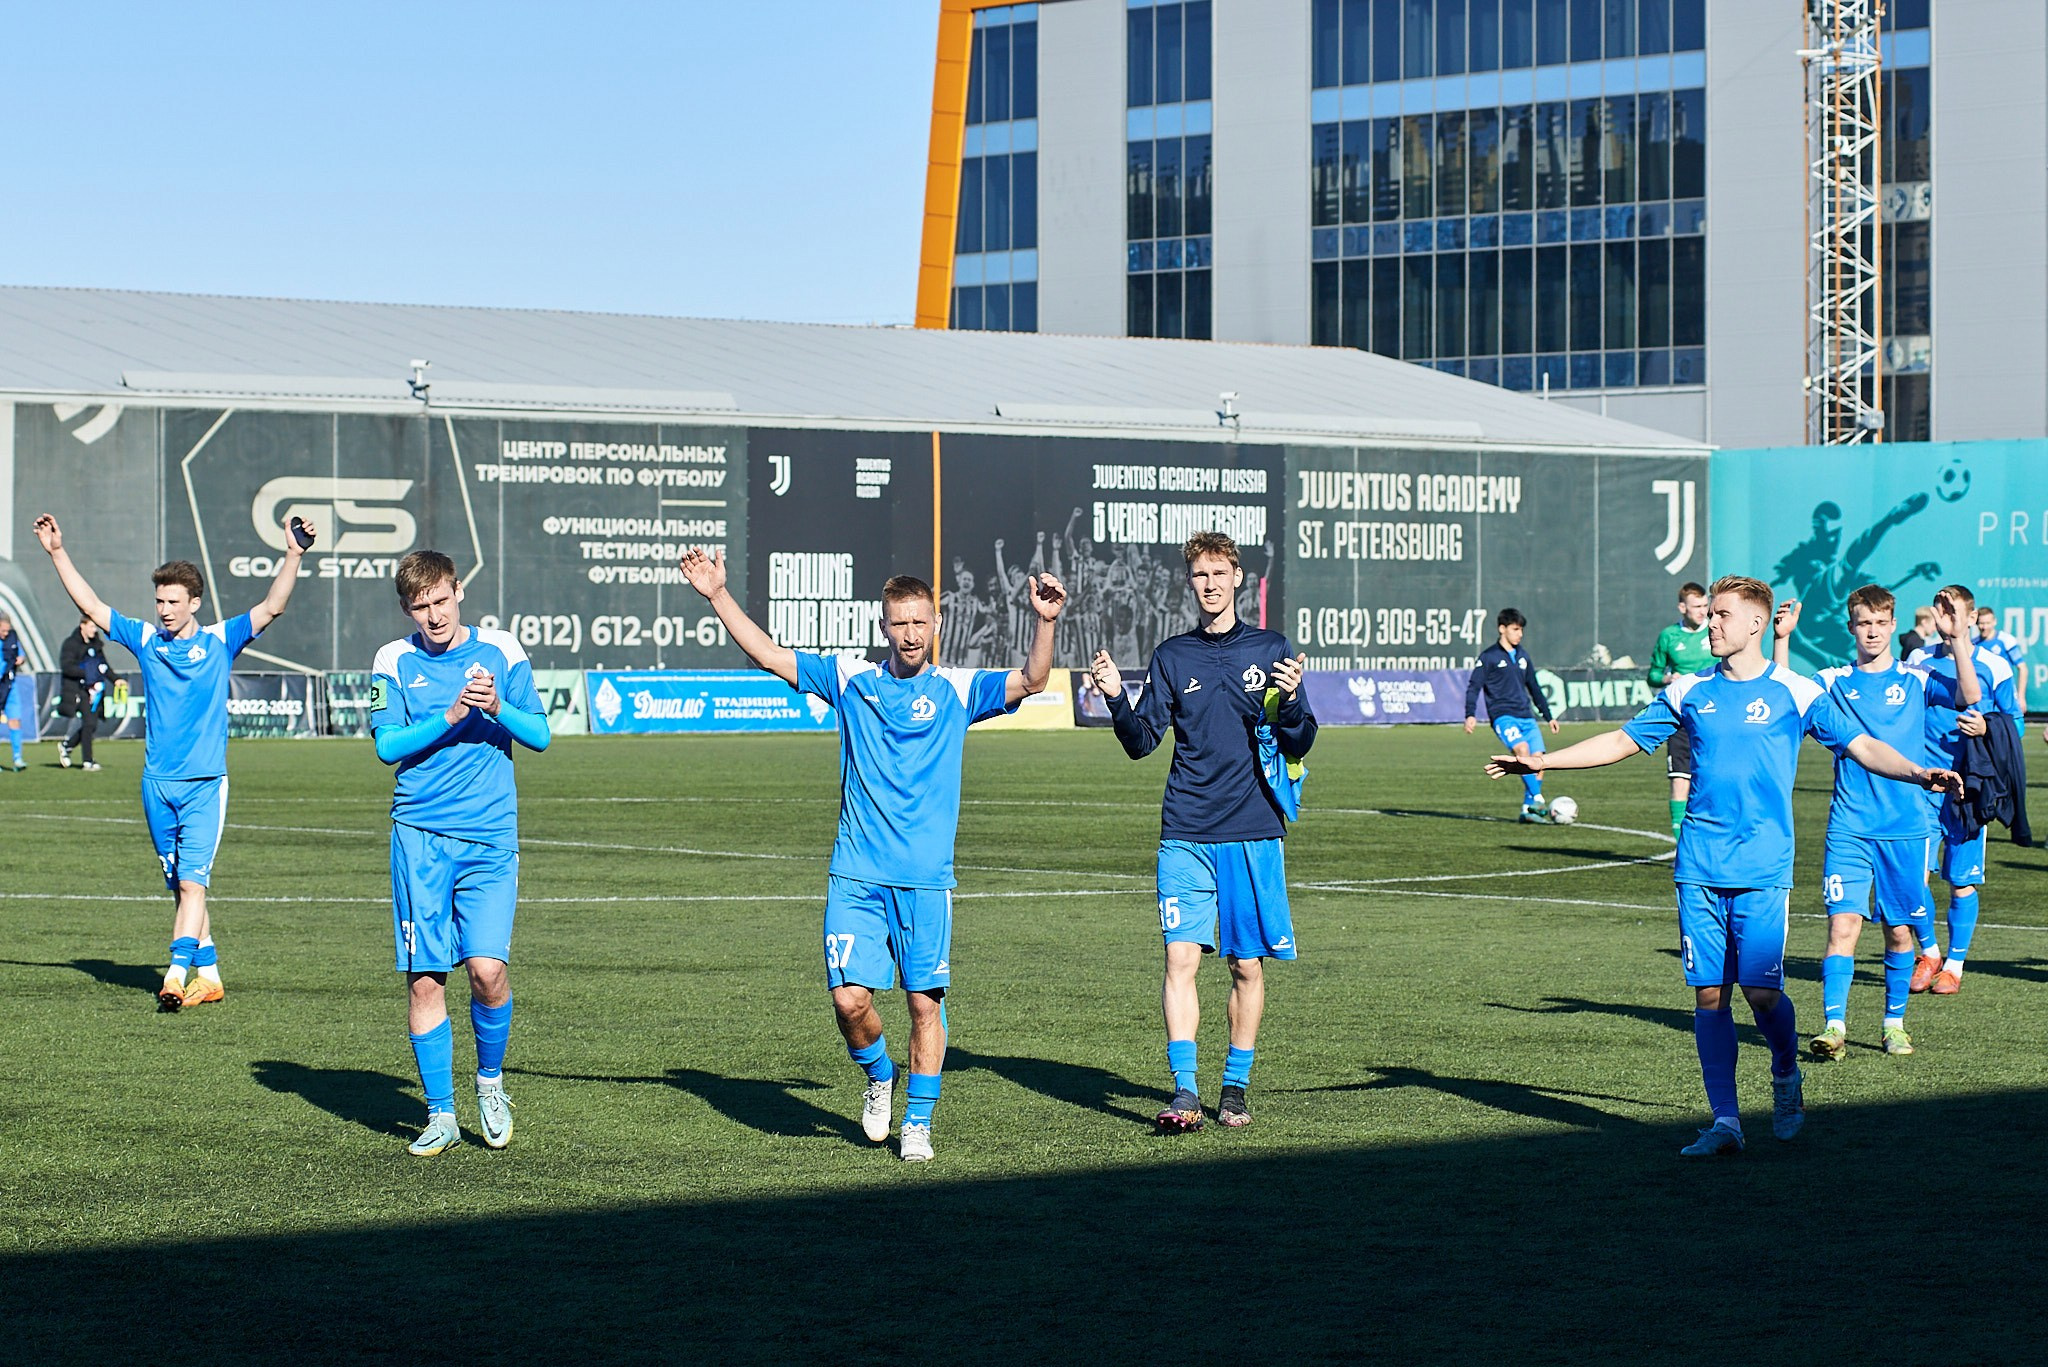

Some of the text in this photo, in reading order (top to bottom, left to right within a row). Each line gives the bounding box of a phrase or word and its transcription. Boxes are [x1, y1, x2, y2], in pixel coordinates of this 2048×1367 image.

[503, 440, 727, 464] ЦЕНТР ПЕРСОНАЛЬНЫХ
[474, 464, 727, 488] ТРЕНИРОВОК ПО ФУТБОЛУ
[1092, 464, 1267, 494] JUVENTUS ACADEMY RUSSIA
[1297, 471, 1521, 513] JUVENTUS ACADEMY
[542, 516, 727, 538] ФУНКЦИОНАЛЬНОЕ
[1093, 501, 1267, 546] 5 YEARS ANNIVERSARY
[1298, 520, 1462, 561] ST. PETERSBURG
[318, 558, 397, 578] STATI
[588, 565, 691, 585] ФУТБОЛИС
[768, 552, 853, 600] GROWING
[510, 614, 582, 653] (812)
[590, 615, 727, 647] 612-01-61
[768, 600, 818, 647] YOUR
[1297, 607, 1487, 648] 8 (812) 309-53-47
[1567, 680, 1652, 708] ЛИГА
[826, 933, 855, 969] 37
